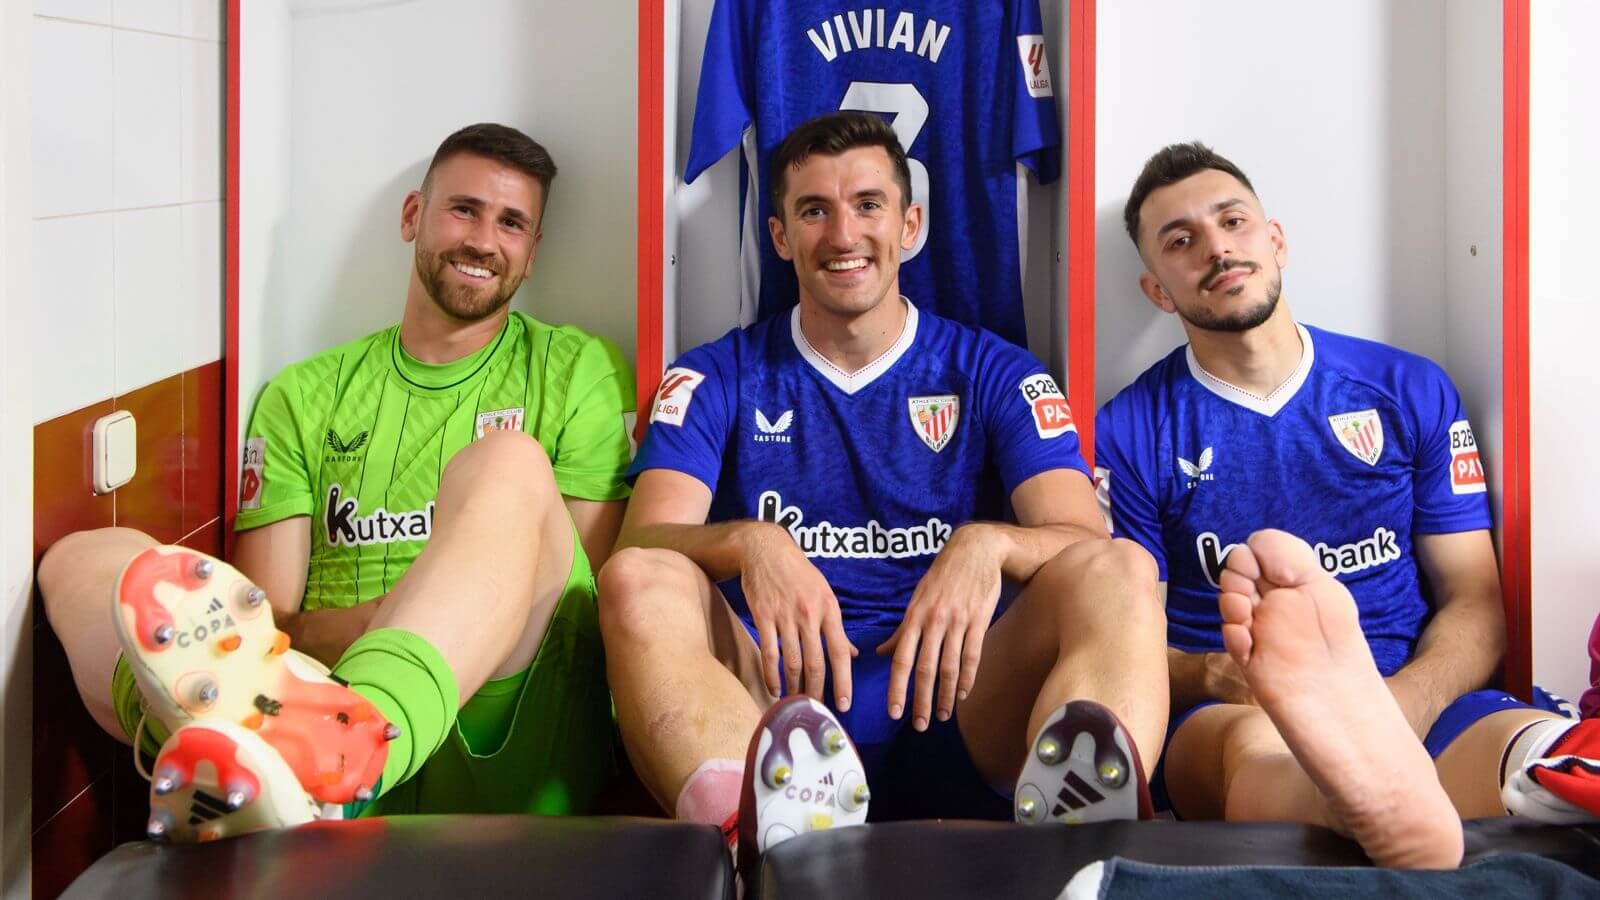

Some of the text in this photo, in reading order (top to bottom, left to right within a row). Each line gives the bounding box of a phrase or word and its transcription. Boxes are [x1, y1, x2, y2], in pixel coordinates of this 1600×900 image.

[807, 9, 951, 63] VIVIAN
[1025, 380, 1058, 400] B2B
[656, 404, 679, 416] LIGA
[754, 434, 791, 443] CASTORE
[1453, 428, 1474, 448] B2B
[177, 615, 236, 649] COPA
[785, 785, 836, 808] COPA
